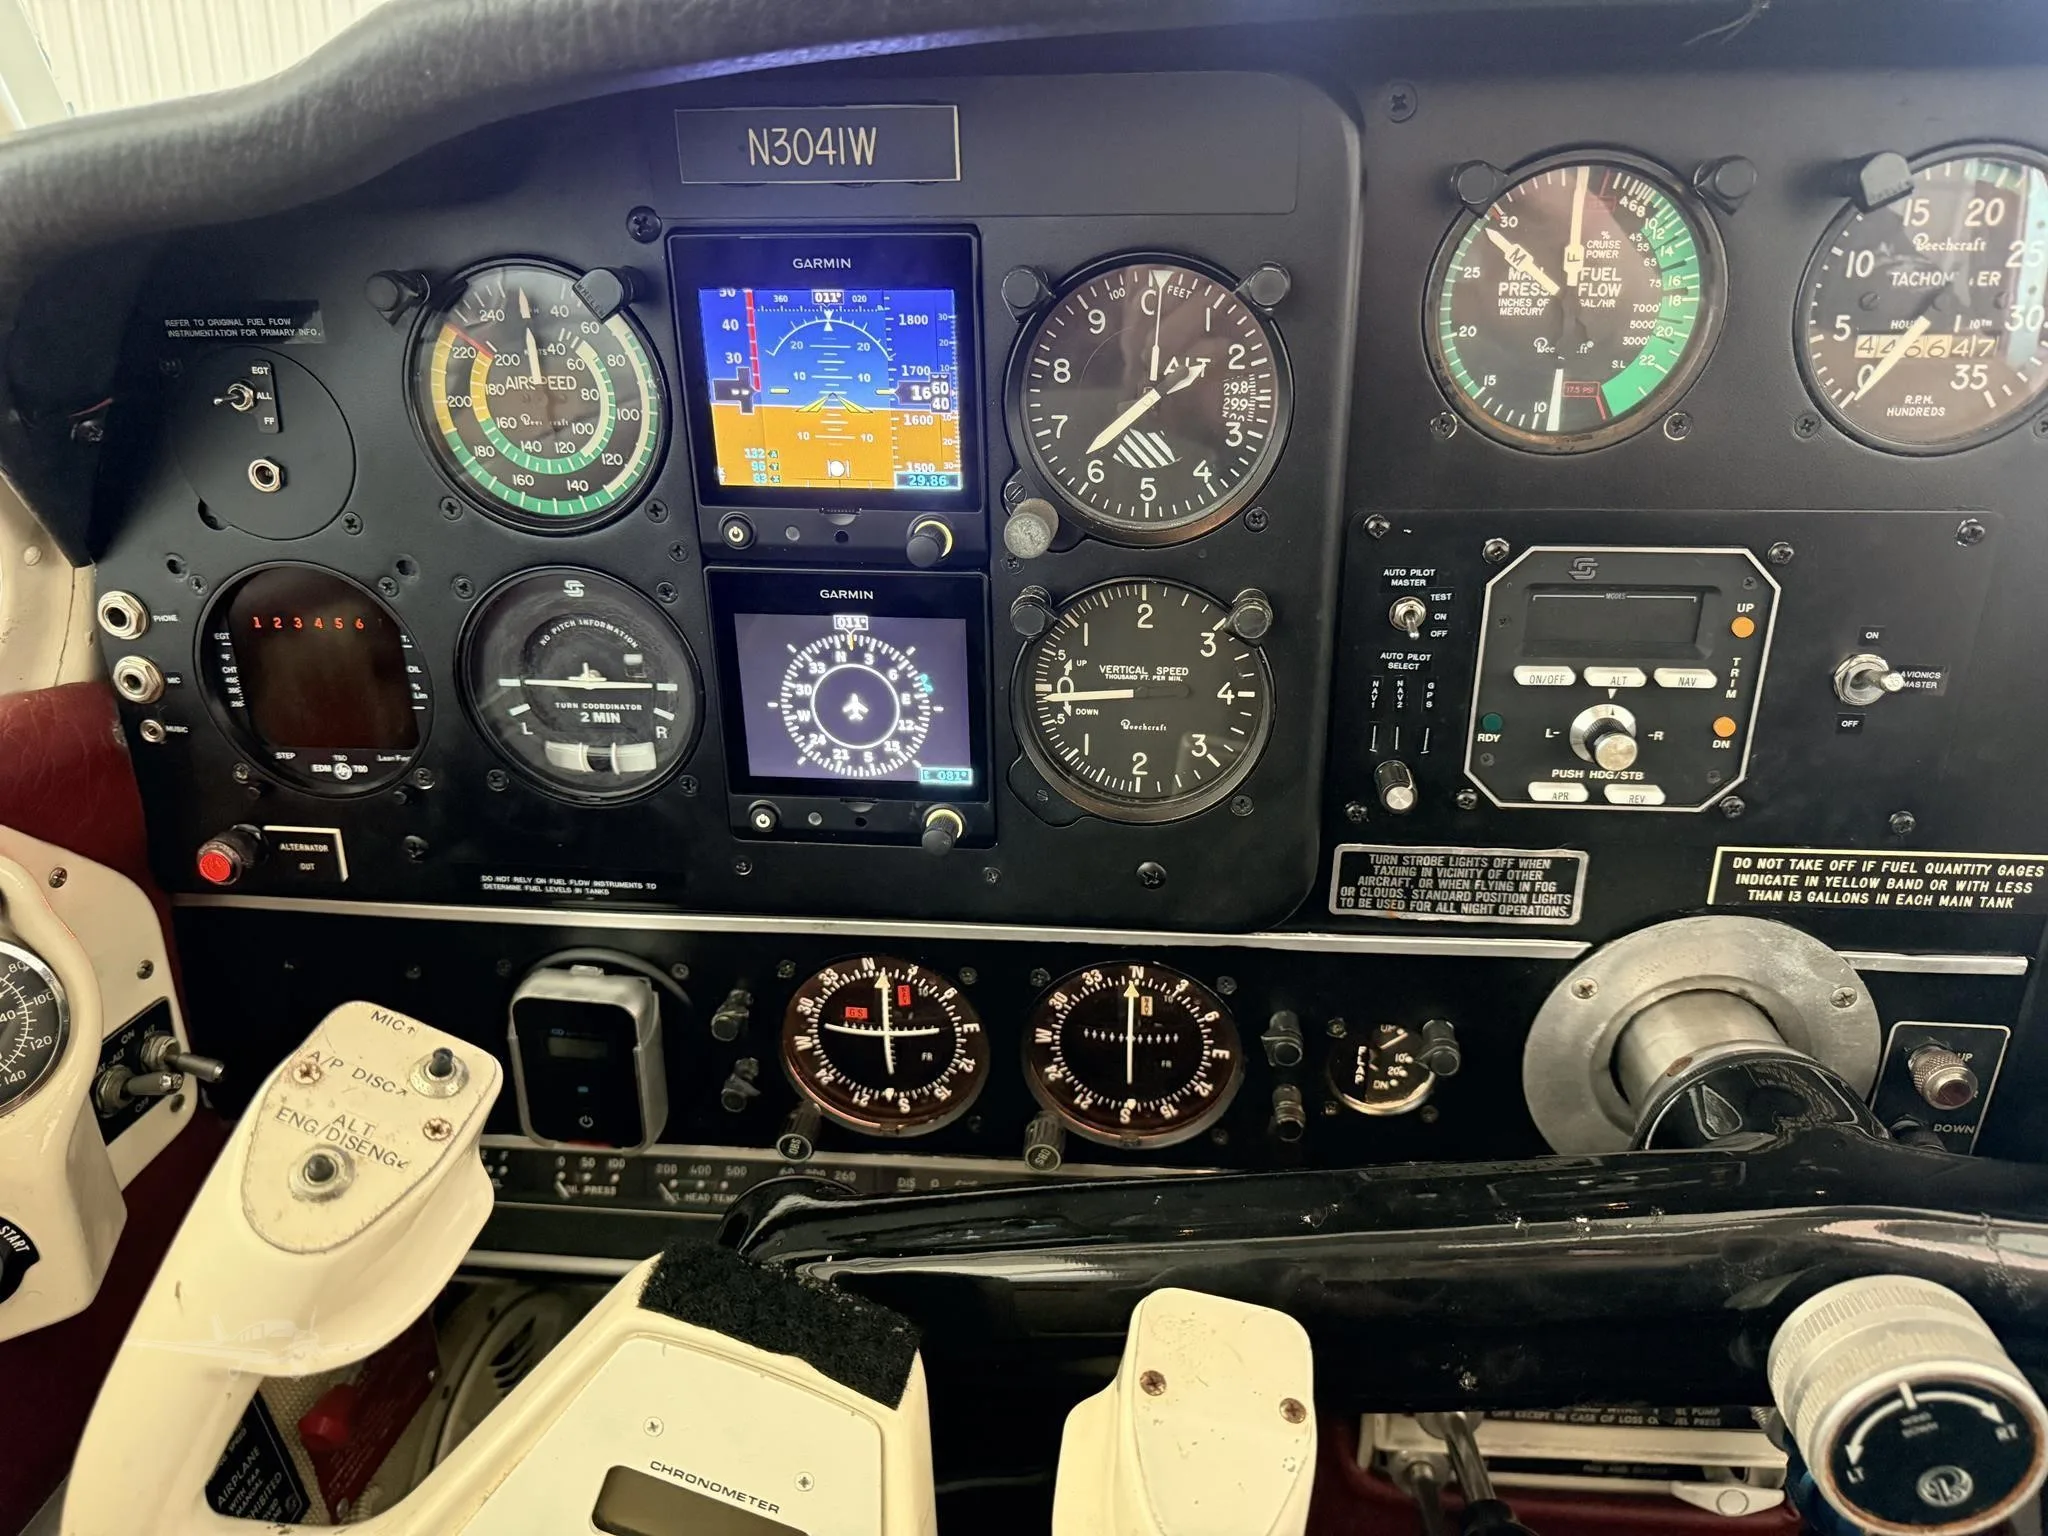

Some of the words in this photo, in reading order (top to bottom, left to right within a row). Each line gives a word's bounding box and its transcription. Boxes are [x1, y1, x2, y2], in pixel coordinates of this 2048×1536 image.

[1903, 199, 1930, 226] 15
[1964, 198, 2005, 227] 20
[1500, 216, 1518, 228] 30
[1586, 240, 1622, 249] CRUISE
[1912, 232, 1988, 251] Beechcraft
[1586, 250, 1619, 259] POWER
[792, 258, 852, 269] GARMIN
[1463, 267, 1480, 278] 25
[1581, 267, 1622, 281] FUEL
[1109, 288, 1126, 300] 100
[1167, 285, 1193, 300] FEET
[1578, 283, 1622, 297] FLOW
[1498, 299, 1534, 307] INCHES
[1537, 299, 1550, 308] OF
[479, 310, 505, 322] 240
[1500, 307, 1544, 316] MERCURY
[165, 319, 190, 327] REFER
[193, 319, 205, 327] TO
[207, 318, 244, 327] ORIGINAL
[246, 318, 266, 326] FUEL
[268, 318, 291, 326] FLOW
[899, 315, 928, 326] 1800
[168, 329, 238, 338] INSTRUMENTATION
[240, 328, 258, 337] FOR
[260, 328, 295, 337] PRIMARY
[298, 328, 321, 337] INFO.
[251, 366, 269, 375] EGT
[902, 365, 931, 376] 1700
[1223, 381, 1248, 395] 29.8
[256, 392, 272, 400] ALL
[1904, 395, 1934, 405] R.P.M.
[1222, 398, 1248, 411] 29.9
[617, 409, 640, 421] 100
[1886, 406, 1945, 417] HUNDREDS
[903, 415, 934, 426] 1600
[909, 475, 947, 487] 29.86
[1383, 569, 1406, 577] AUTO
[1410, 569, 1435, 577] PILOT
[820, 589, 874, 600] GARMIN
[1430, 593, 1452, 601] TEST
[1736, 603, 1754, 613] UP
[1434, 613, 1447, 621] ON
[539, 634, 551, 647] NO
[552, 620, 577, 636] PITCH
[579, 619, 639, 649] INFORMATION
[1430, 630, 1448, 638] OFF
[1865, 631, 1879, 639] ON
[1407, 653, 1431, 661] PILOT
[1076, 659, 1087, 667] UP
[1388, 662, 1420, 670] SELECT
[1099, 664, 1149, 675] VERTICAL
[1156, 666, 1189, 676] SPEED
[1899, 671, 1941, 680] AVIONICS
[1529, 674, 1566, 684] ON/OFF
[1610, 675, 1628, 685] ALT
[1677, 676, 1697, 686] NAV
[1902, 680, 1938, 689] MASTER
[582, 703, 642, 711] COORDINATOR
[1075, 708, 1099, 716] DOWN
[580, 712, 591, 723] 2
[592, 712, 621, 724] MIN
[1120, 719, 1167, 731] Beechcraft
[1841, 720, 1859, 728] OFF
[1477, 733, 1501, 742] RDY
[1712, 740, 1730, 749] DN
[1551, 769, 1584, 779] PUSH
[1589, 770, 1644, 780] HDG/STB
[1551, 791, 1569, 801] APR
[1629, 794, 1646, 804] REV
[280, 843, 329, 852] ALTERNATOR
[299, 862, 315, 871] OUT
[1369, 854, 1398, 866] TURN
[1402, 855, 1444, 867] STROBE
[1449, 857, 1488, 868] LIGHTS
[1493, 858, 1514, 868] OFF
[1518, 859, 1551, 869] WHEN
[1374, 865, 1417, 877] TAXIING
[1421, 867, 1432, 877] IN
[1437, 868, 1483, 879] VICINITY
[1488, 869, 1502, 880] OF
[1507, 870, 1543, 880] OTHER
[1733, 857, 1751, 869] DO
[1757, 858, 1784, 870] NOT
[1789, 858, 1824, 871] TAKE
[1829, 860, 1856, 872] OFF
[1862, 860, 1876, 873] IF
[1881, 861, 1918, 874] FUEL
[1924, 862, 1992, 877] QUANTITY
[1997, 864, 2045, 878] GAGES
[495, 875, 511, 883] NOT
[513, 876, 533, 884] RELY
[549, 877, 567, 885] FUEL
[569, 878, 591, 886] FLOW
[593, 880, 643, 889] INSTRUMENTS
[646, 882, 657, 890] TO
[1357, 876, 1414, 888] AIRCRAFT,
[1419, 878, 1433, 889] OR
[1438, 879, 1470, 890] WHEN
[1475, 880, 1515, 891] FLYING
[1519, 882, 1530, 892] IN
[1535, 882, 1557, 892] FOG
[1735, 874, 1798, 887] INDICATE
[1804, 876, 1820, 887] IN
[1825, 876, 1880, 889] YELLOW
[1886, 878, 1923, 891] BAND
[1929, 879, 1948, 891] OR
[1955, 880, 1989, 893] WITH
[1995, 881, 2033, 894] LESS
[482, 883, 522, 891] DETERMINE
[524, 885, 543, 893] FUEL
[545, 886, 572, 894] LEVELS
[585, 887, 610, 895] TANKS
[1340, 886, 1355, 897] OR
[1360, 887, 1406, 899] CLOUDS.
[1411, 889, 1471, 902] STANDARD
[1476, 892, 1527, 904] POSITION
[1532, 894, 1572, 905] LIGHTS
[1748, 890, 1783, 902] THAN
[1789, 891, 1801, 903] 13
[1806, 891, 1869, 904] GALLONS
[1875, 893, 1890, 905] IN
[1896, 894, 1933, 906] EACH
[1938, 895, 1974, 908] MAIN
[1979, 896, 2014, 909] TANK
[1340, 897, 1354, 908] TO
[1358, 898, 1372, 909] BE
[1376, 899, 1405, 910] USED
[1410, 901, 1431, 912] FOR
[1435, 902, 1456, 913] ALL
[1460, 903, 1494, 915] NIGHT
[1498, 905, 1570, 918] OPERATIONS.
[370, 1010, 405, 1032] MIC
[29, 1035, 53, 1052] 120
[307, 1050, 344, 1069] A/P
[351, 1067, 397, 1094] DISC
[331, 1113, 377, 1137] ALT
[1933, 1123, 1975, 1134] DOWN
[275, 1106, 402, 1167] ENG/DISENG
[649, 1460, 781, 1514] CHRONOMETER
